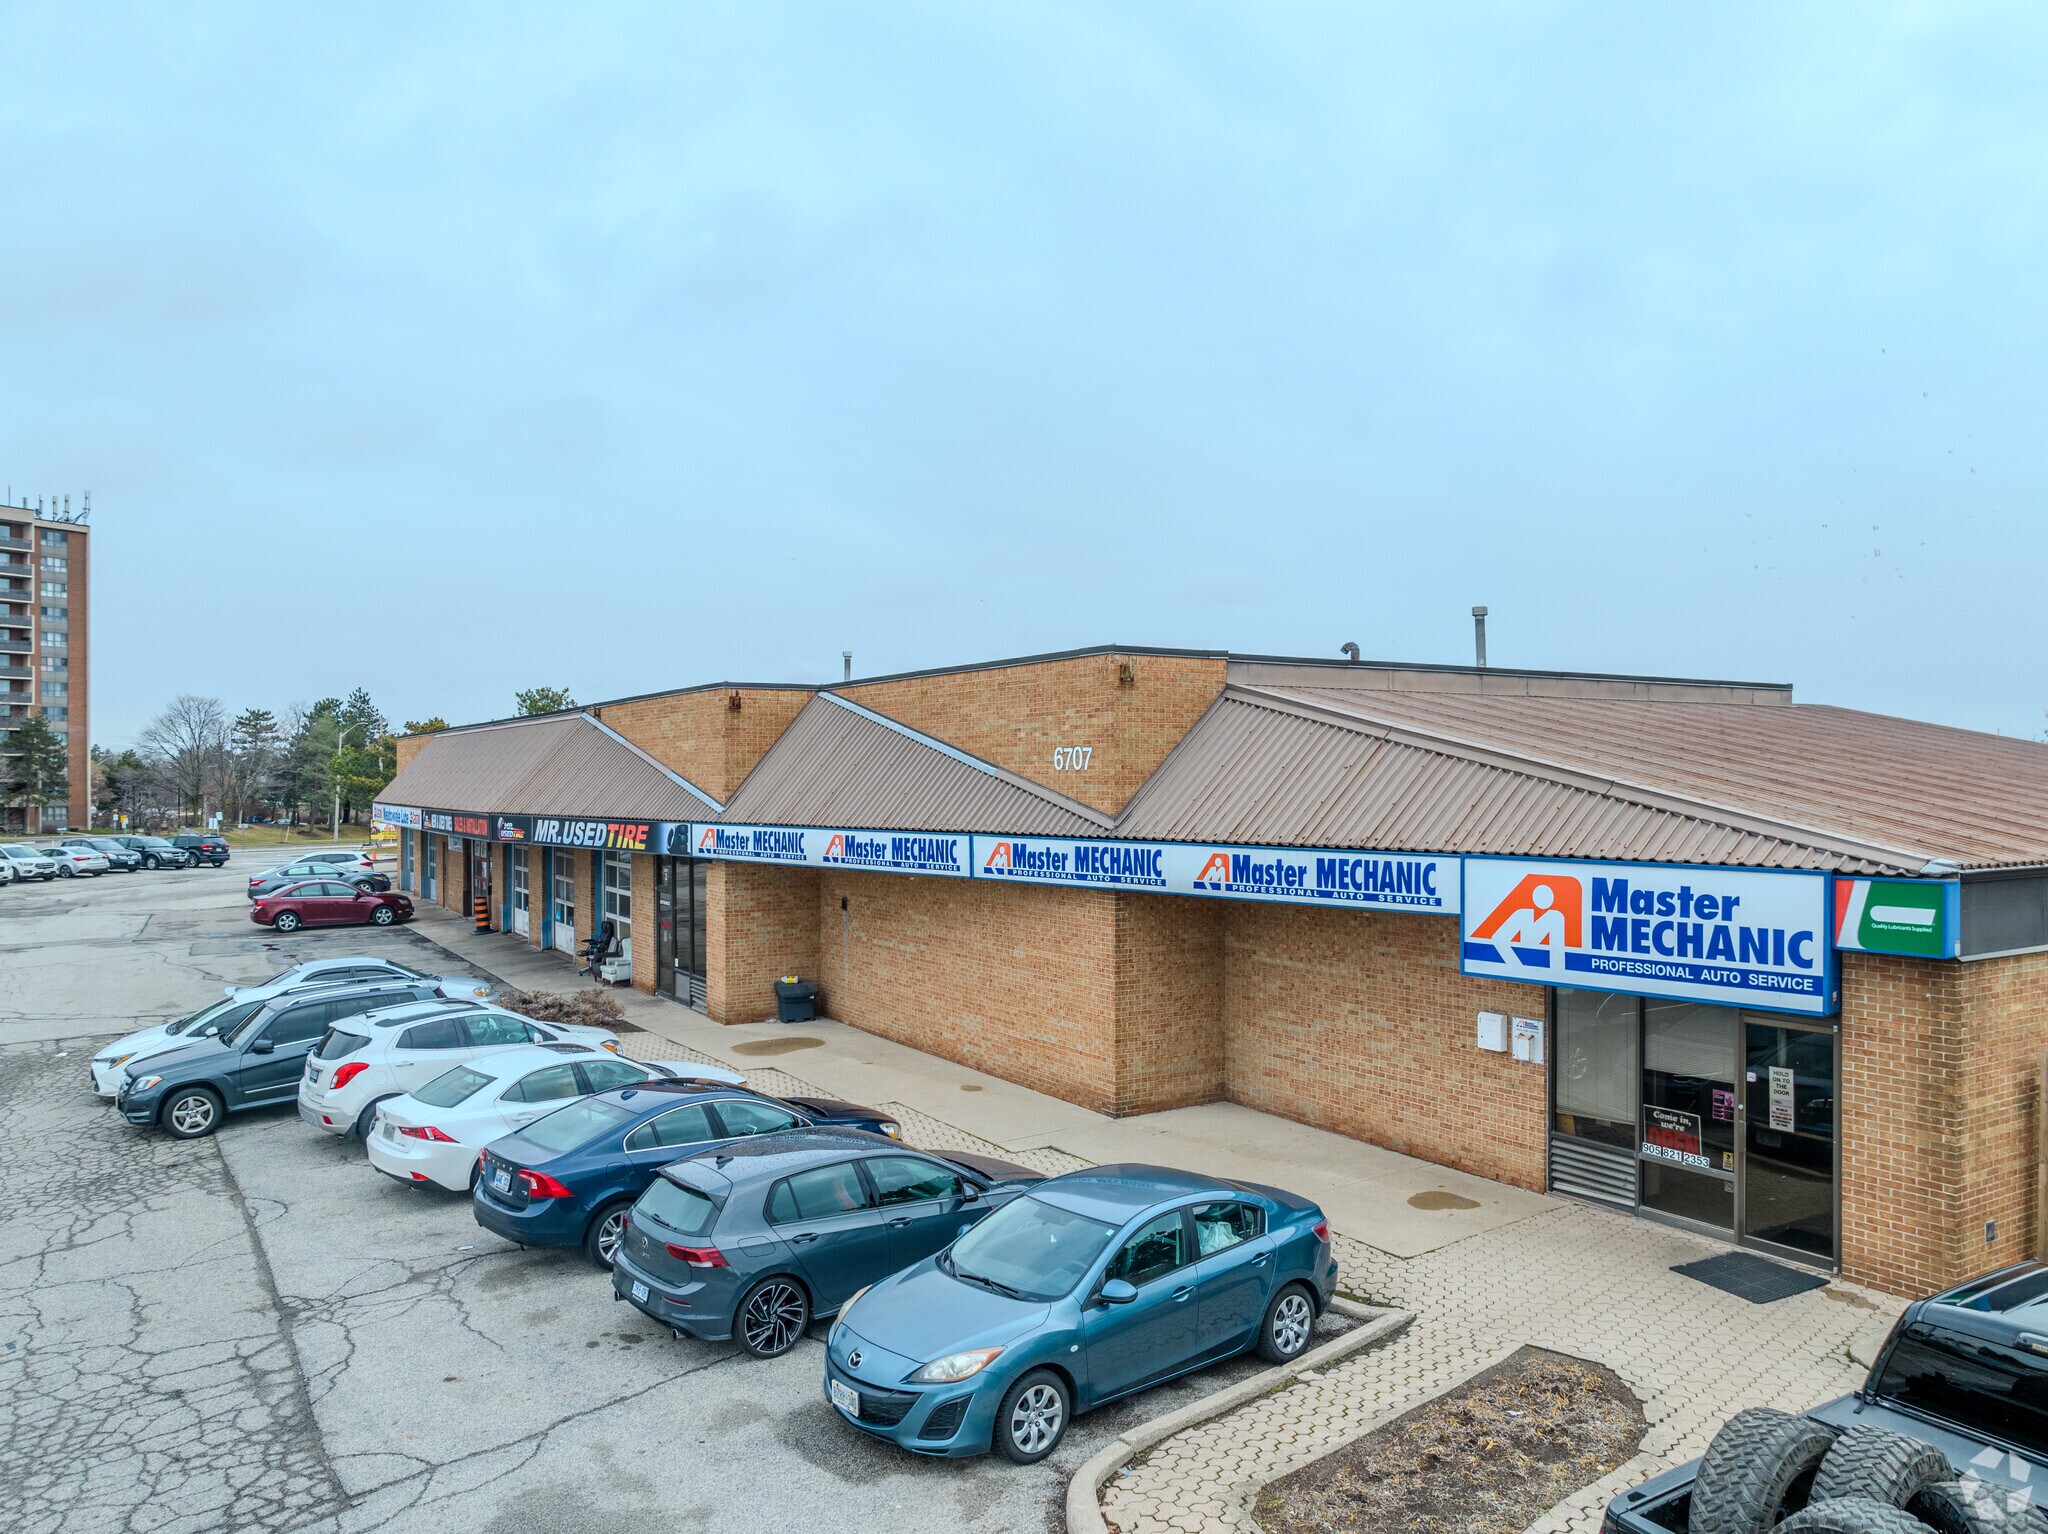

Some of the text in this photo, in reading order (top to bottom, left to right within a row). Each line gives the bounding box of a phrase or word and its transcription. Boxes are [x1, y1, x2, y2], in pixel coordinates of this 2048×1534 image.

[1053, 746, 1093, 771] 6707
[715, 849, 756, 858] PROFESSIONAL
[716, 829, 805, 854] Master MECHANIC
[845, 835, 958, 864] Master MECHANIC
[844, 858, 895, 867] PROFESSIONAL
[925, 863, 959, 871] SERVICE
[1012, 843, 1163, 878] Master MECHANIC
[1012, 869, 1078, 880] PROFESSIONAL
[1120, 877, 1163, 886] SERVICE
[1232, 854, 1437, 896] Master MECHANIC
[1232, 885, 1437, 906] PROFESSIONAL AUTO SERVICE
[1592, 877, 1740, 922] Master
[1871, 922, 1888, 930] Quality
[1591, 915, 1814, 969] MECHANIC
[1591, 958, 1814, 991] PROFESSIONAL AUTO SERVICE
[1653, 1110, 1692, 1126] Come in,
[1660, 1121, 1685, 1132] we're
[1647, 1126, 1699, 1155] OPEN
[1643, 1143, 1661, 1155] 905
[1663, 1149, 1680, 1160] 821
[1684, 1153, 1709, 1167] 2353
